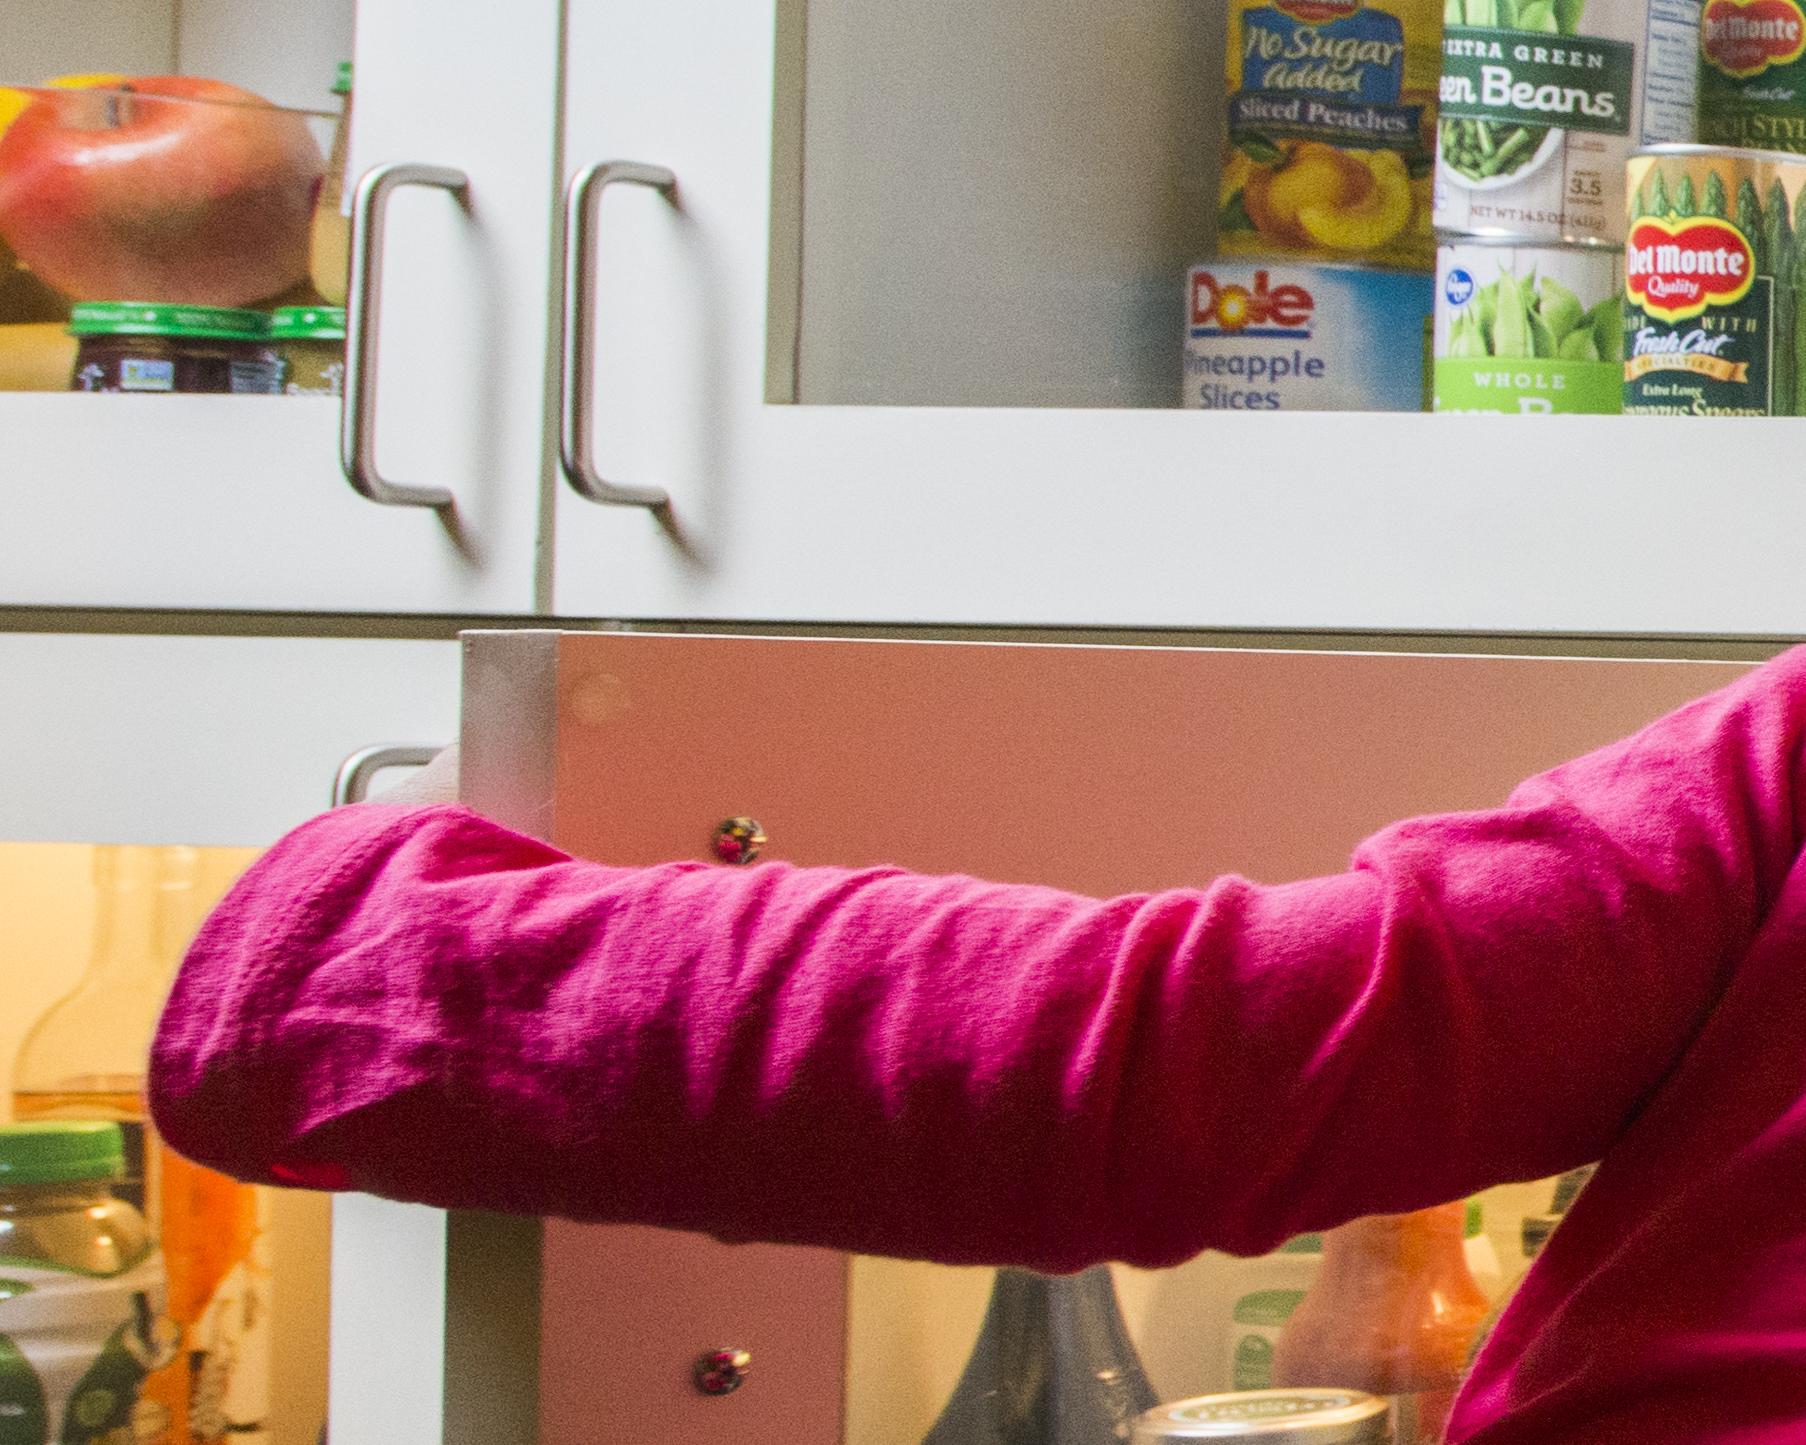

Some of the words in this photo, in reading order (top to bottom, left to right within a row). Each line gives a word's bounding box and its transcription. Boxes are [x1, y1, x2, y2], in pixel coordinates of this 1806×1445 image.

[1729, 16, 1799, 42] Monte
[1244, 26, 1284, 60] No
[1283, 26, 1404, 72] Sugar
[1513, 44, 1603, 69] GREEN
[1262, 62, 1364, 93] Added
[1480, 65, 1616, 118] Beans
[1238, 97, 1300, 122] Sliced
[1307, 102, 1409, 132] Peaches
[1569, 177, 1602, 197] 3.5
[1470, 205, 1497, 218] NET
[1498, 207, 1518, 220] WT
[1628, 246, 1654, 276] Del
[1656, 244, 1745, 276] Monte
[1647, 275, 1699, 298] Quality
[1191, 269, 1315, 332] Dole
[1701, 316, 1758, 333] WITH
[1632, 326, 1680, 357] Fresh
[1679, 328, 1736, 356] Cut
[1473, 372, 1567, 390] WHOLE
[1642, 384, 1670, 396] Extra
[1200, 384, 1281, 410] Slices
